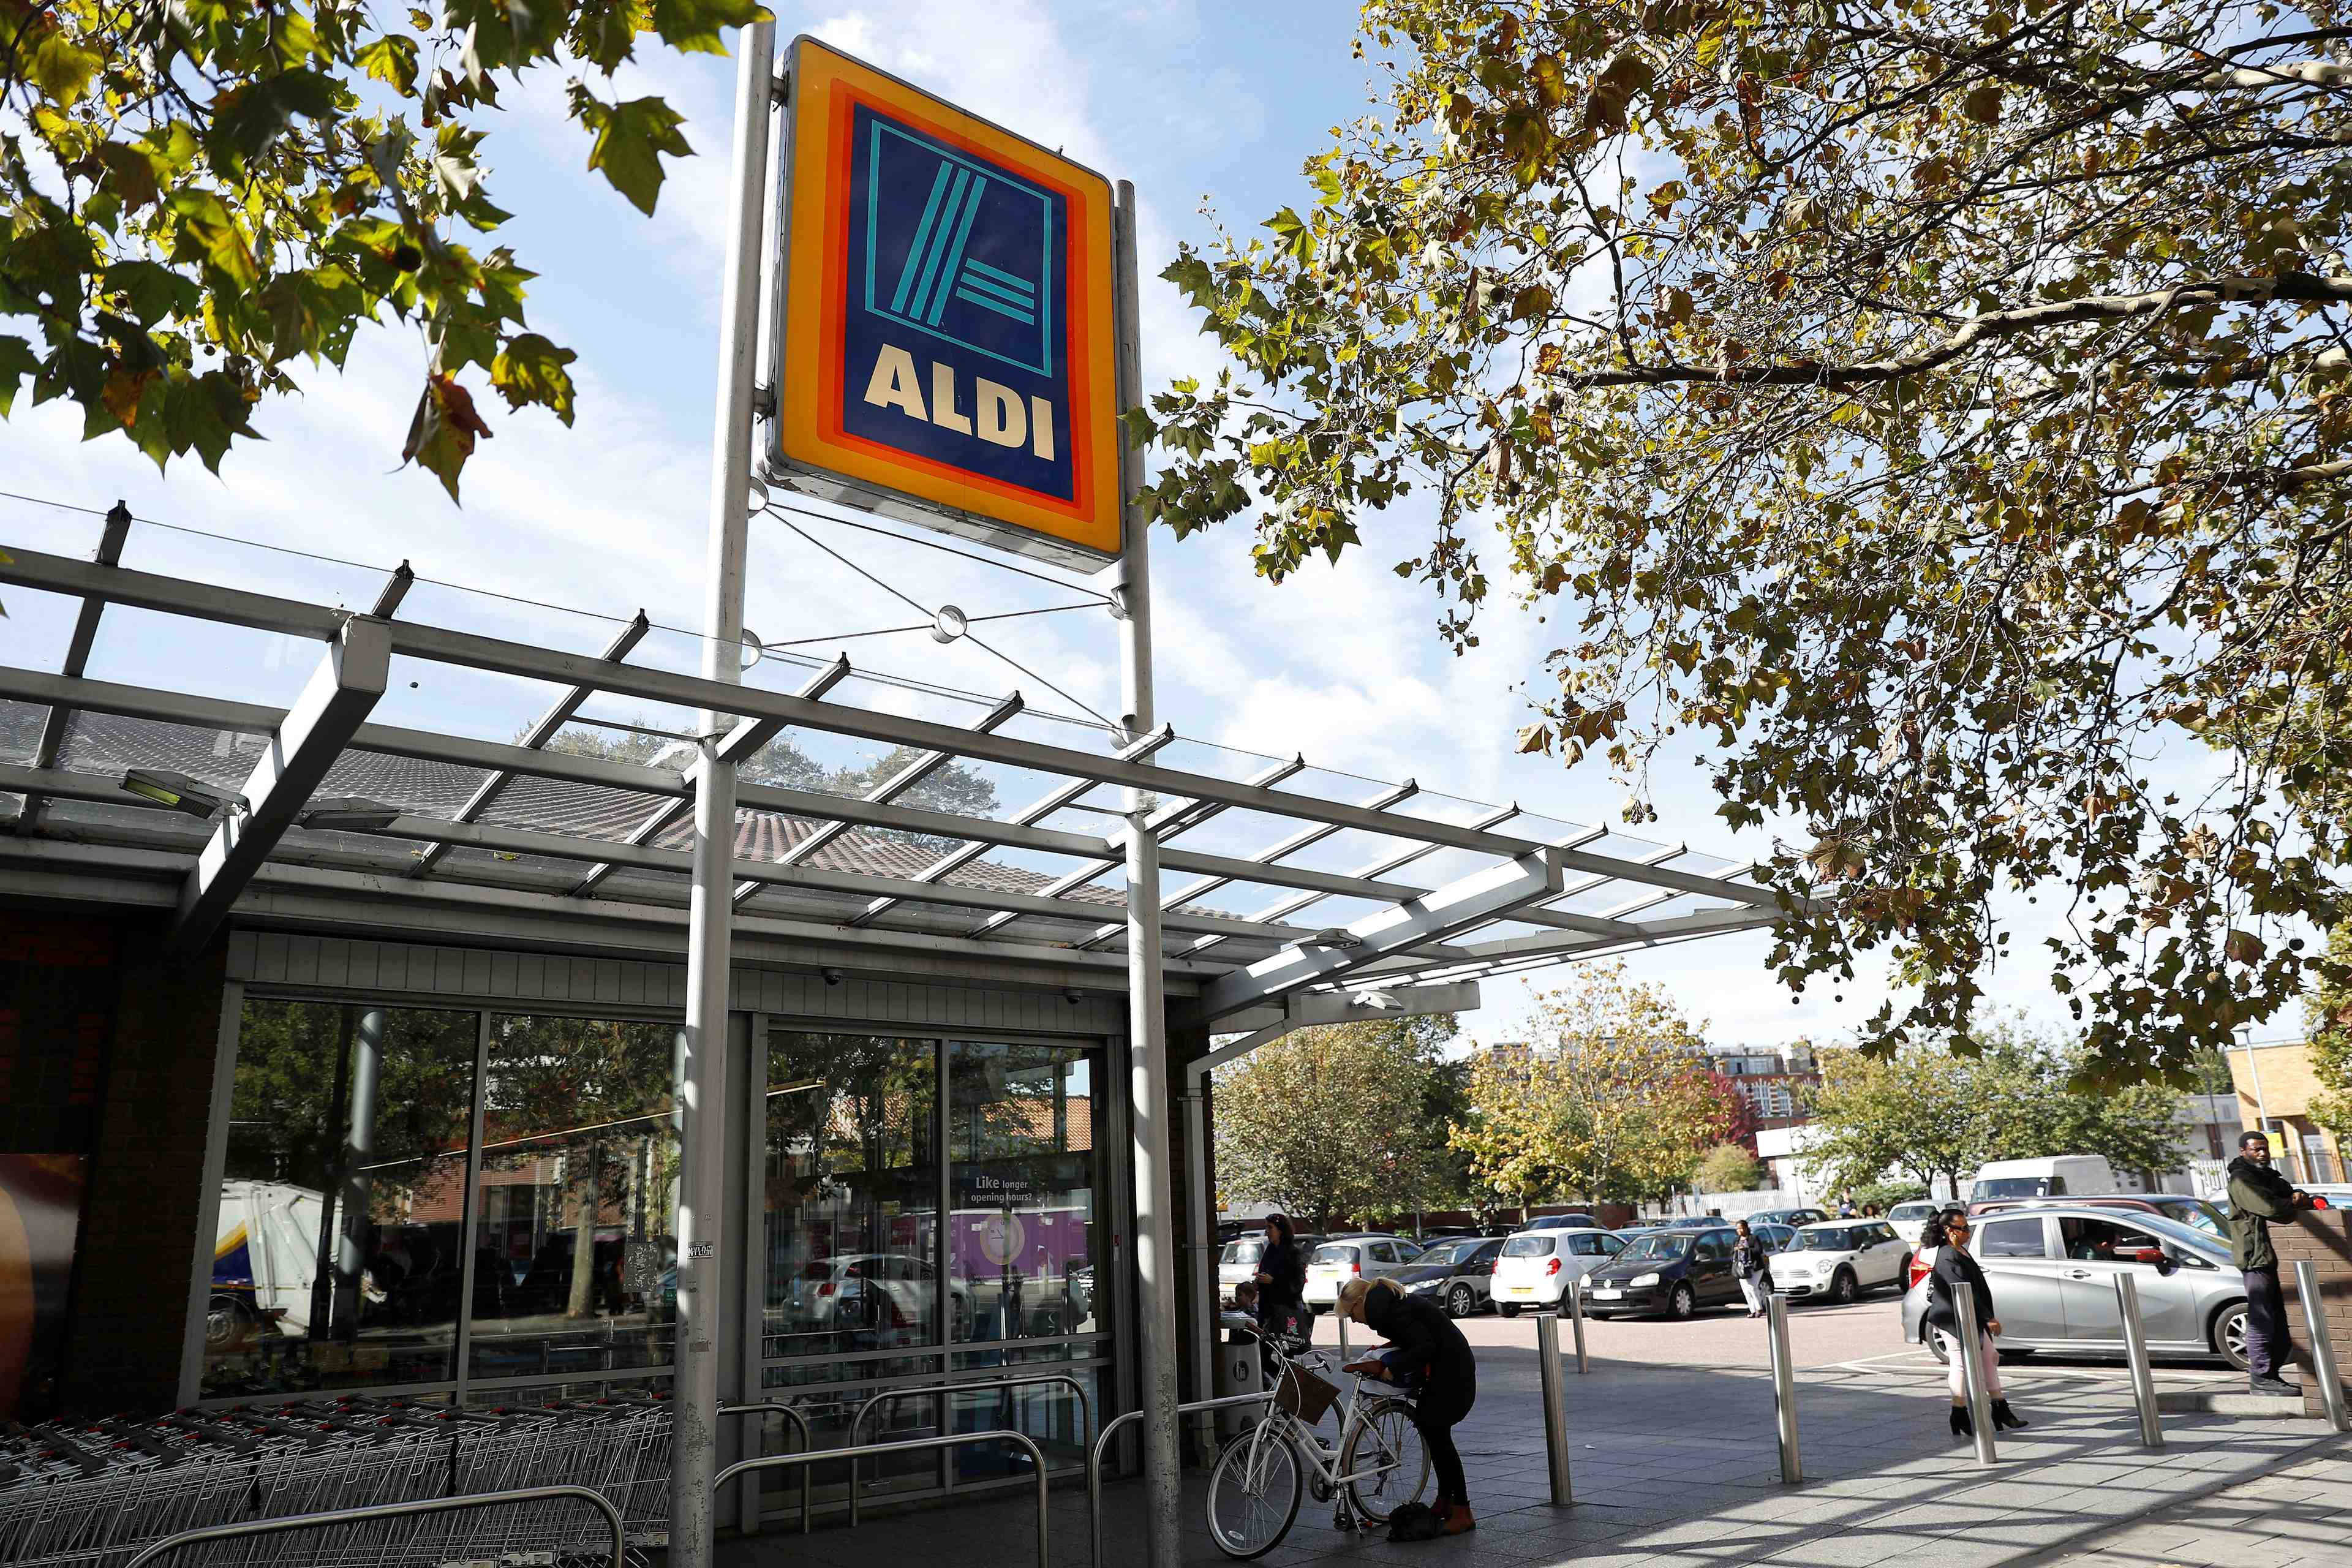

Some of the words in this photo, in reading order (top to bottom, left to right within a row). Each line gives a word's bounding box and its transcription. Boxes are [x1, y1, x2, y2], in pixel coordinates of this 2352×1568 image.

[864, 343, 1055, 462] ALDI
[976, 1176, 1000, 1188] Like
[1003, 1180, 1028, 1191] longer
[971, 1192, 1005, 1204] opening
[1006, 1192, 1032, 1201] hours?
